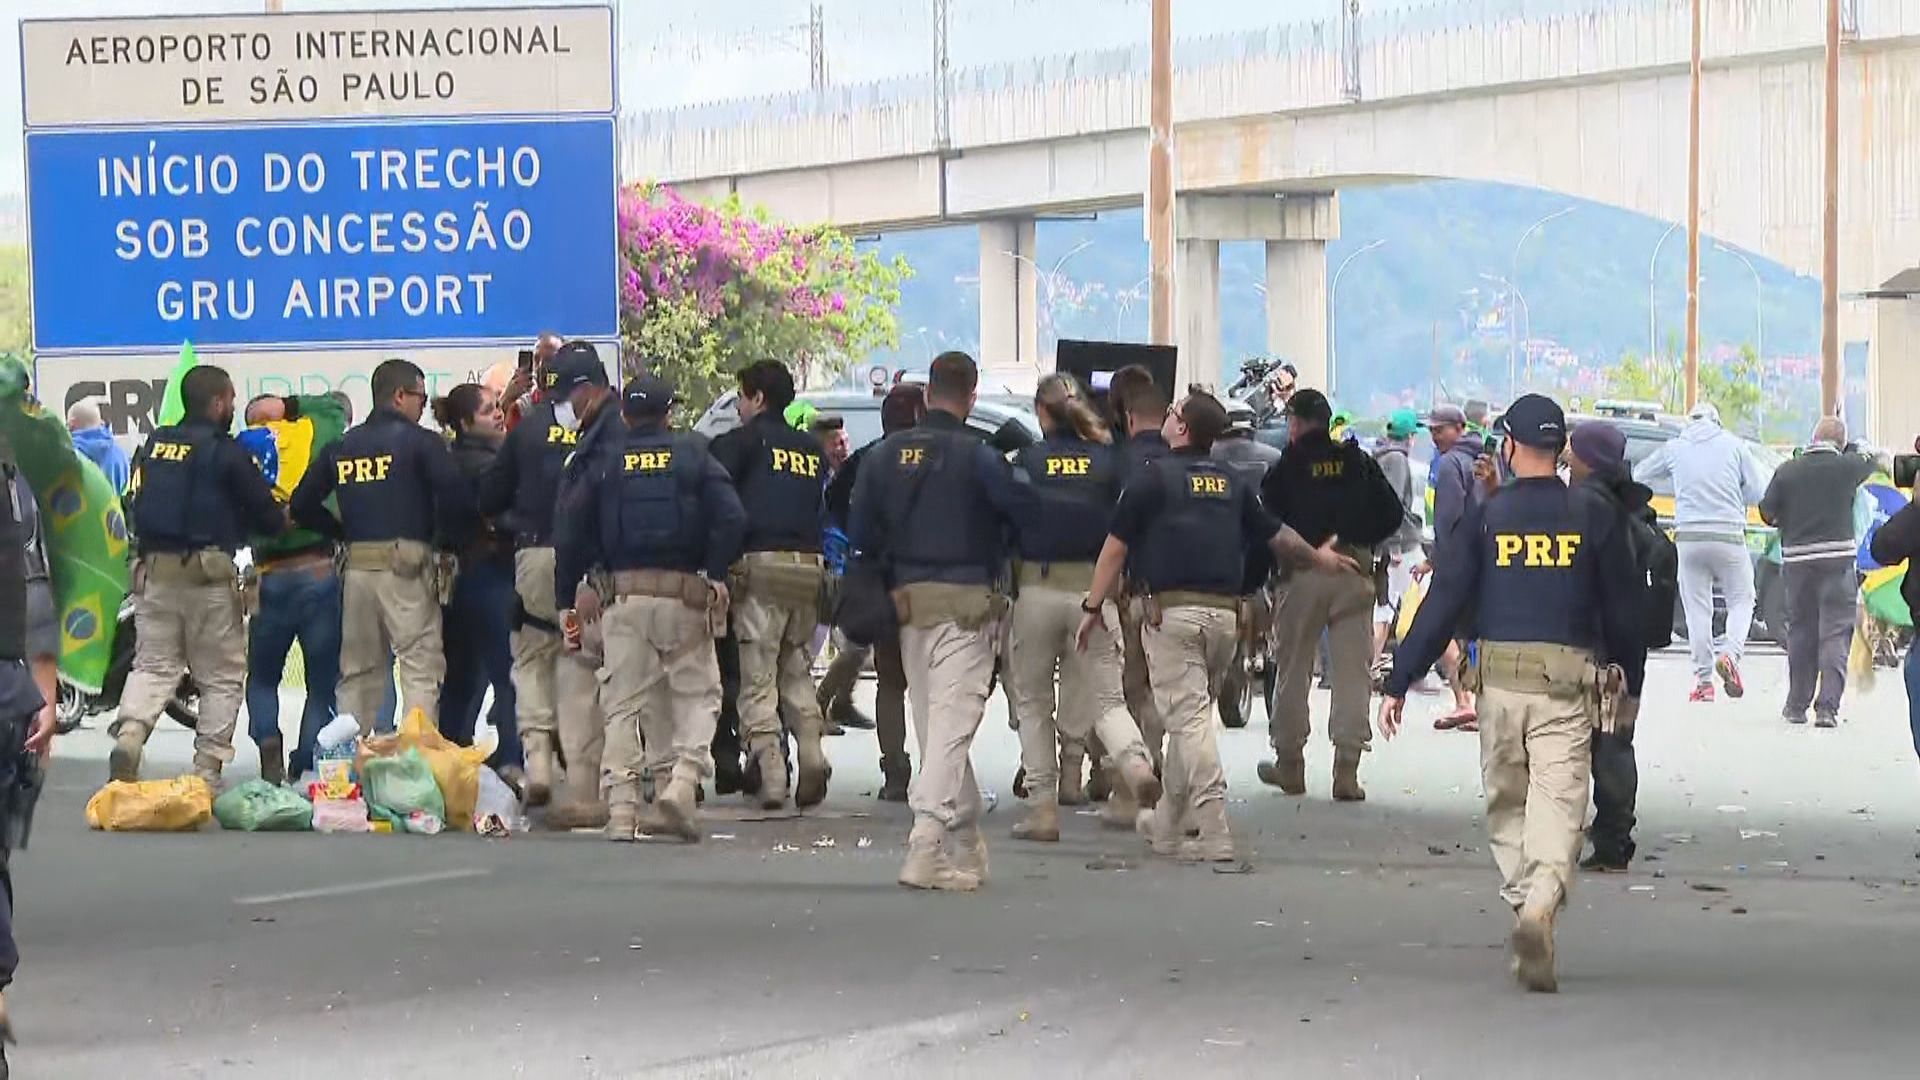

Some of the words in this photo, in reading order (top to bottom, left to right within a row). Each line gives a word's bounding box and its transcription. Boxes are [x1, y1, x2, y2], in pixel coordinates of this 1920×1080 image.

[66, 33, 271, 65] AEROPORTO
[296, 26, 571, 60] INTERNACIONAL
[183, 77, 224, 105] DE
[249, 69, 318, 104] SÃO
[342, 71, 455, 101] PAULO
[98, 141, 238, 196] INÍCIO
[264, 153, 326, 193] DO
[351, 146, 541, 191] TRECHO
[115, 218, 209, 260] SOB
[236, 201, 532, 257] CONCESSÃO
[157, 279, 255, 321] GRU
[283, 274, 493, 319] AIRPORT
[150, 443, 192, 461] PRF
[624, 452, 671, 470] PRF
[773, 449, 819, 477] PRF
[1046, 458, 1091, 475] PRF
[336, 454, 392, 484] PRF
[1311, 460, 1344, 477] PRF
[1191, 476, 1227, 492] PRF
[1496, 533, 1582, 567] PRF
